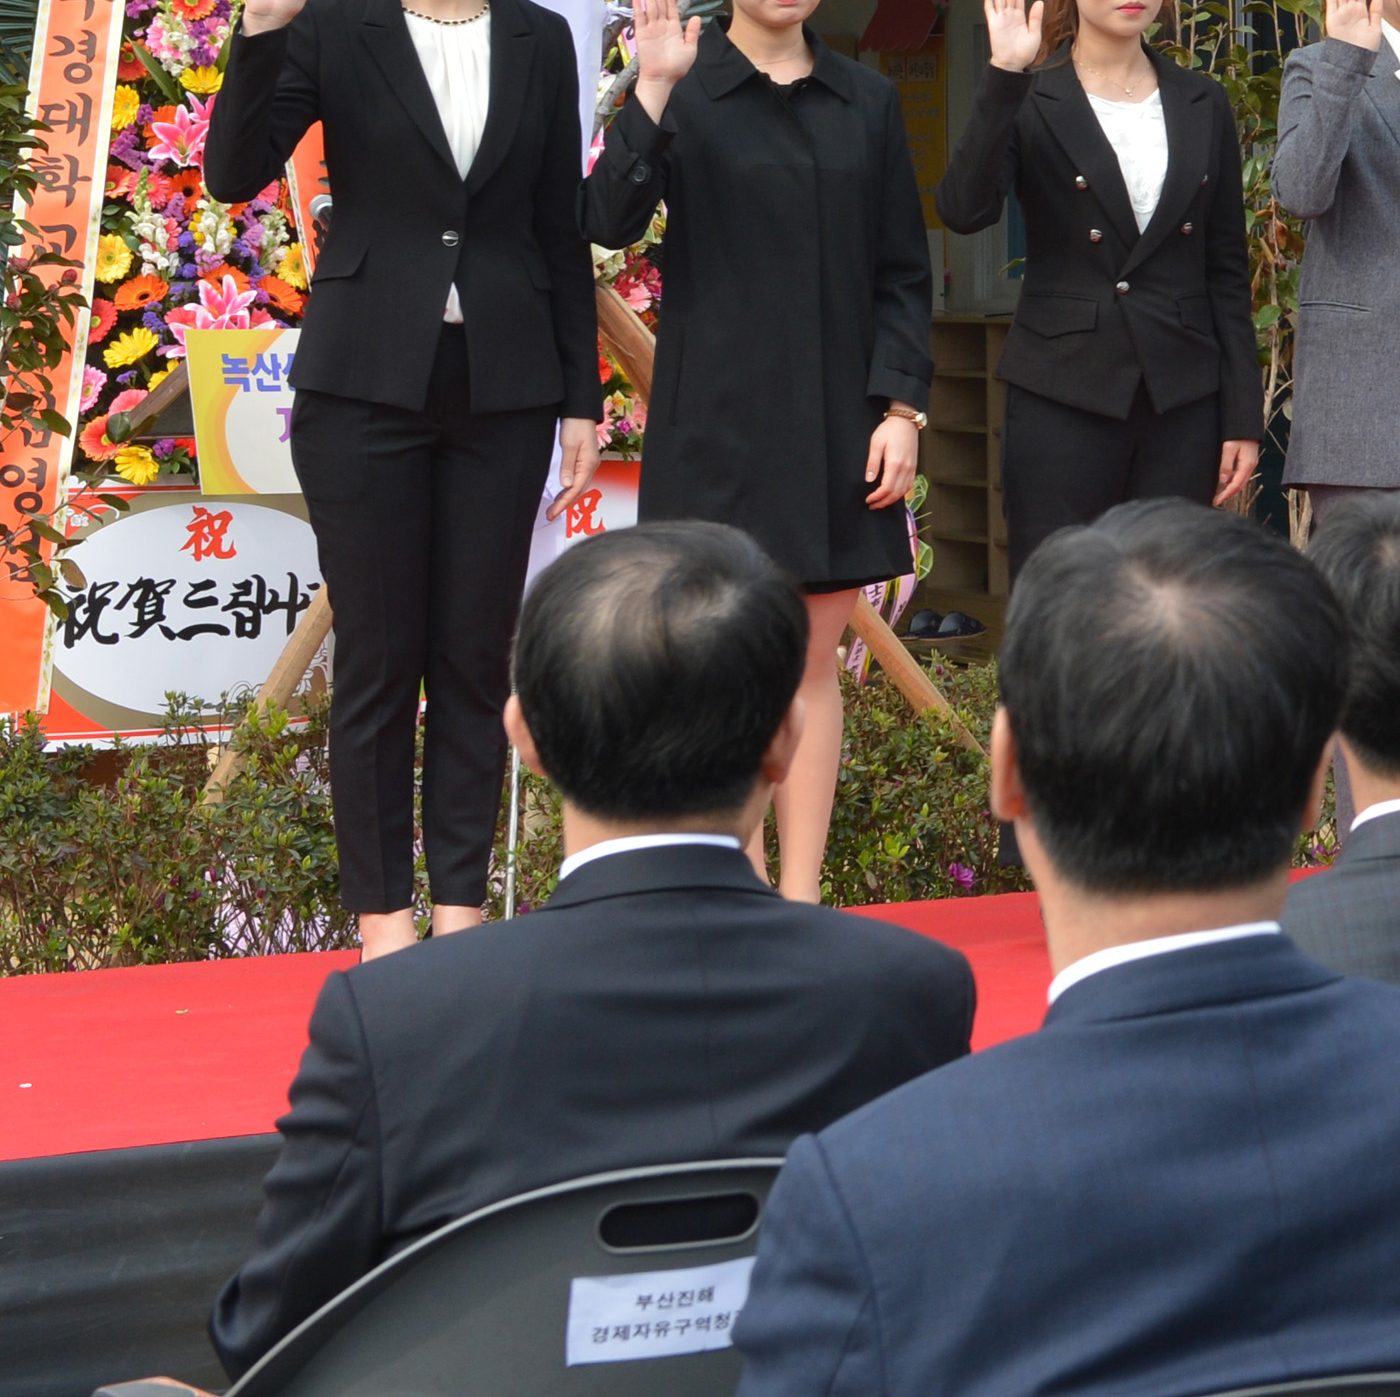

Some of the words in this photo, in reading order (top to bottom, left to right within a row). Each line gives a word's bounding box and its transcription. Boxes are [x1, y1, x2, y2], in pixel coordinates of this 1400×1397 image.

[180, 505, 238, 563] 祝
[635, 1285, 716, 1311] 부산진해
[591, 1310, 740, 1344] 경제자유구역청
